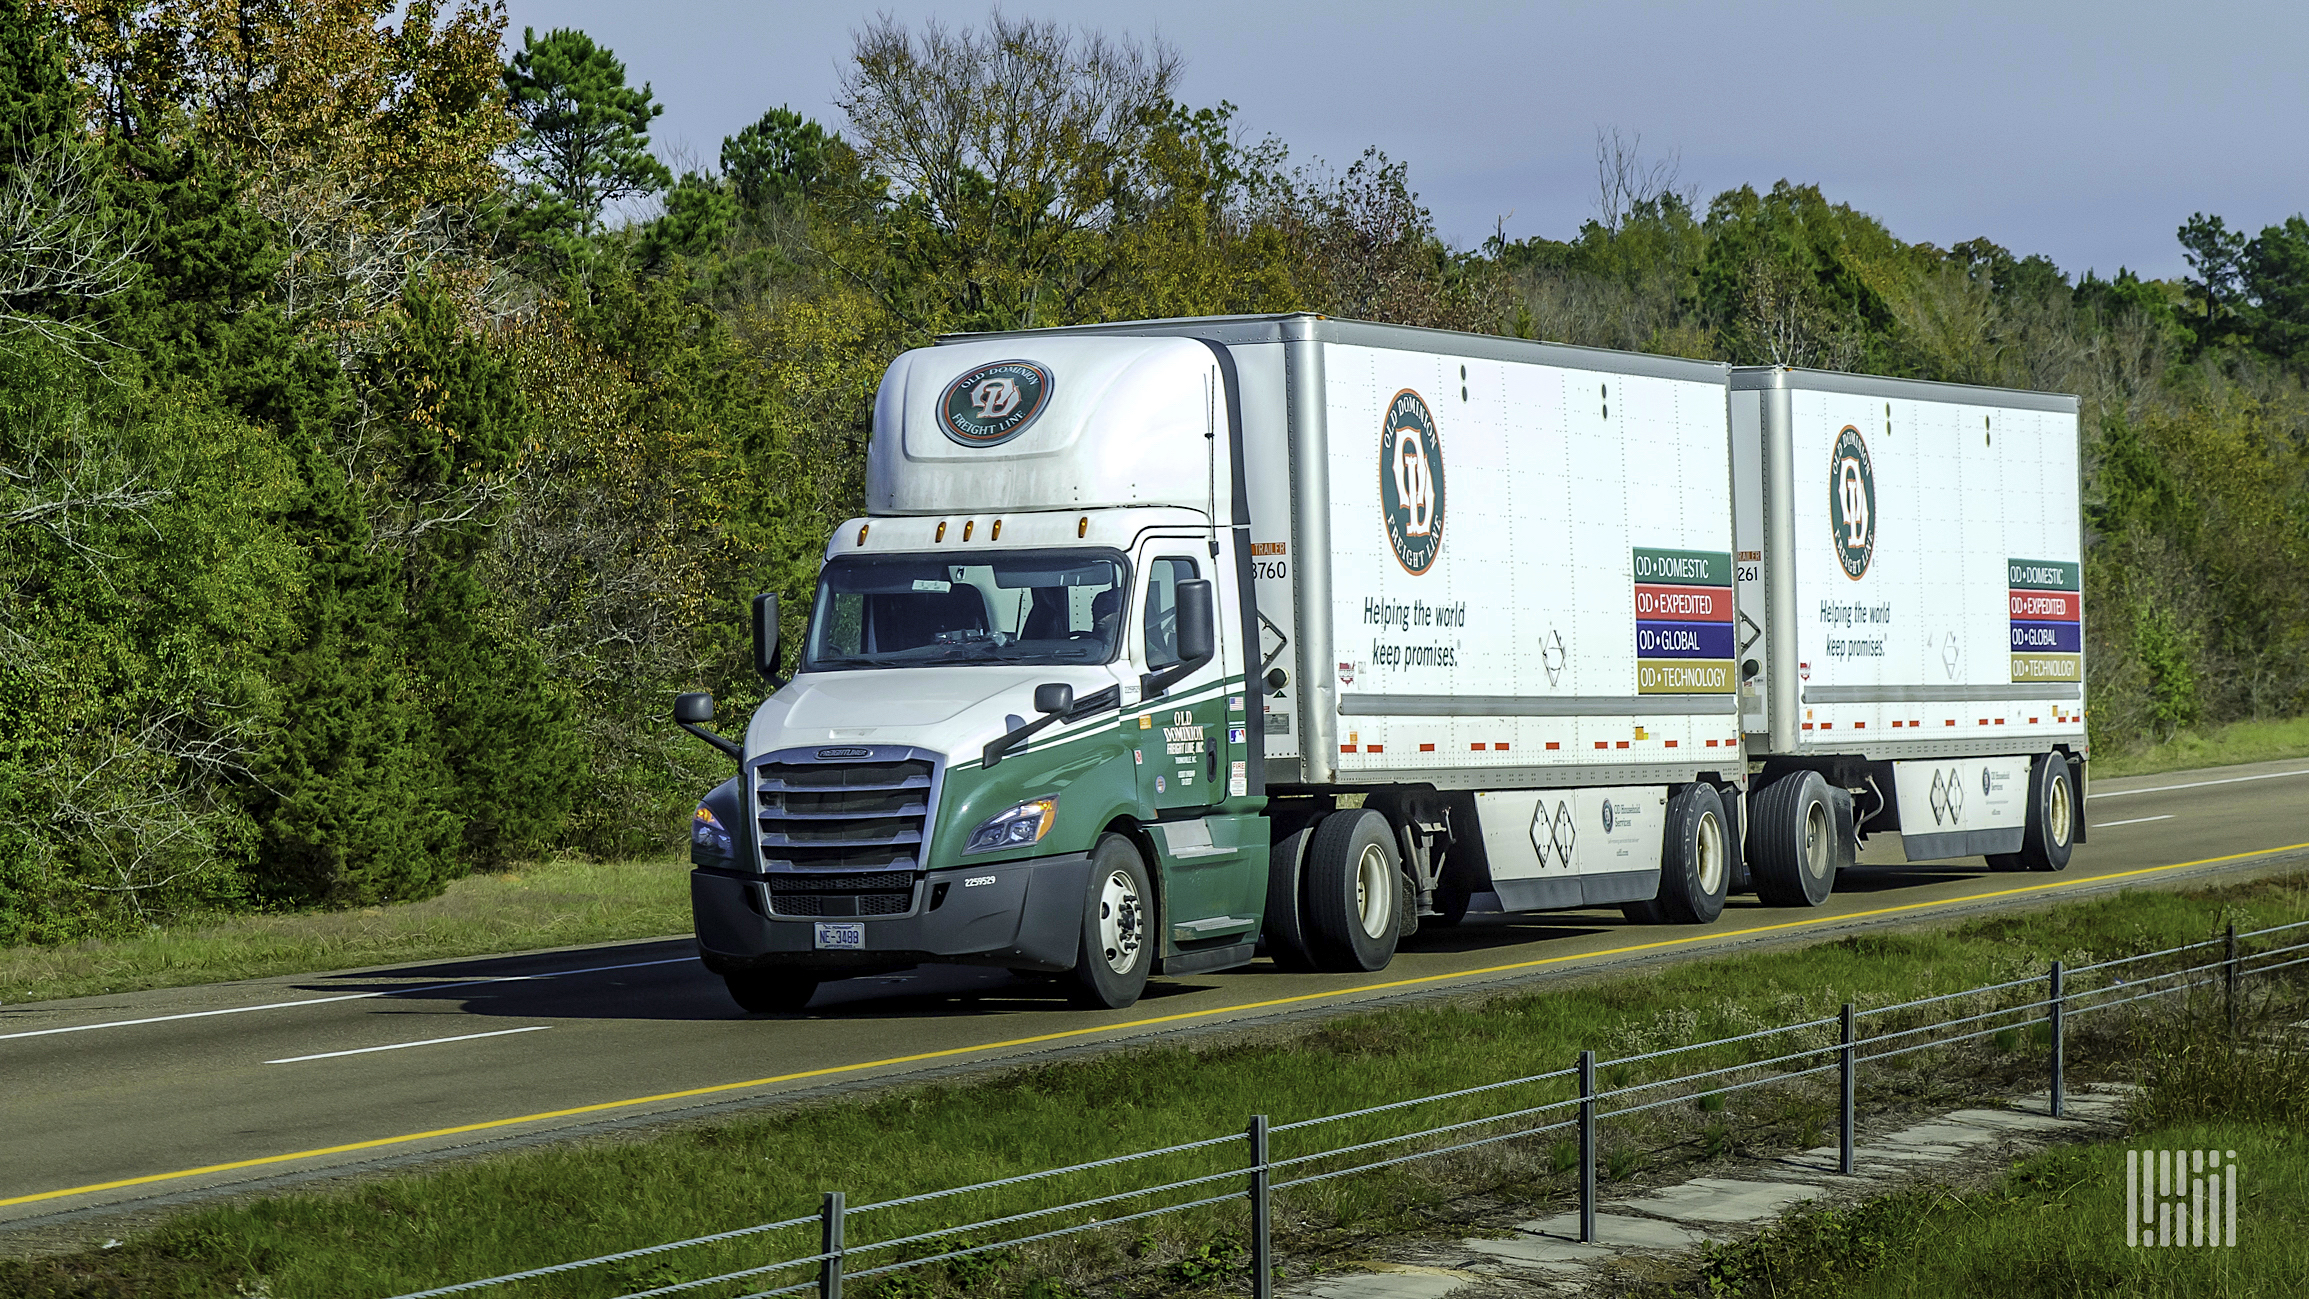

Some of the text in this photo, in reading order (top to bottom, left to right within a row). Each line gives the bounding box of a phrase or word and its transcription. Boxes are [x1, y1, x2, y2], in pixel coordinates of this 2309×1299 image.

[960, 366, 1040, 389] OLD DOMINION
[952, 410, 1026, 435] FREIGHT LINE
[1384, 396, 1438, 450] OLD DOMINION
[1832, 431, 1871, 476] OLD DOMINION
[1254, 543, 1285, 556] TRAILER
[1387, 513, 1442, 568] FREIGHT LINE
[1834, 528, 1874, 574] FREIGHT LINE
[1738, 566, 1758, 582] 261
[1364, 596, 1466, 632] Helping the world
[1820, 600, 1890, 628] Helping the world
[1372, 638, 1458, 672] keep promises.
[1826, 633, 1846, 662] keep
[1174, 710, 1193, 726] OLD
[1162, 726, 1204, 742] DOMINION
[964, 875, 996, 888] 2259529
